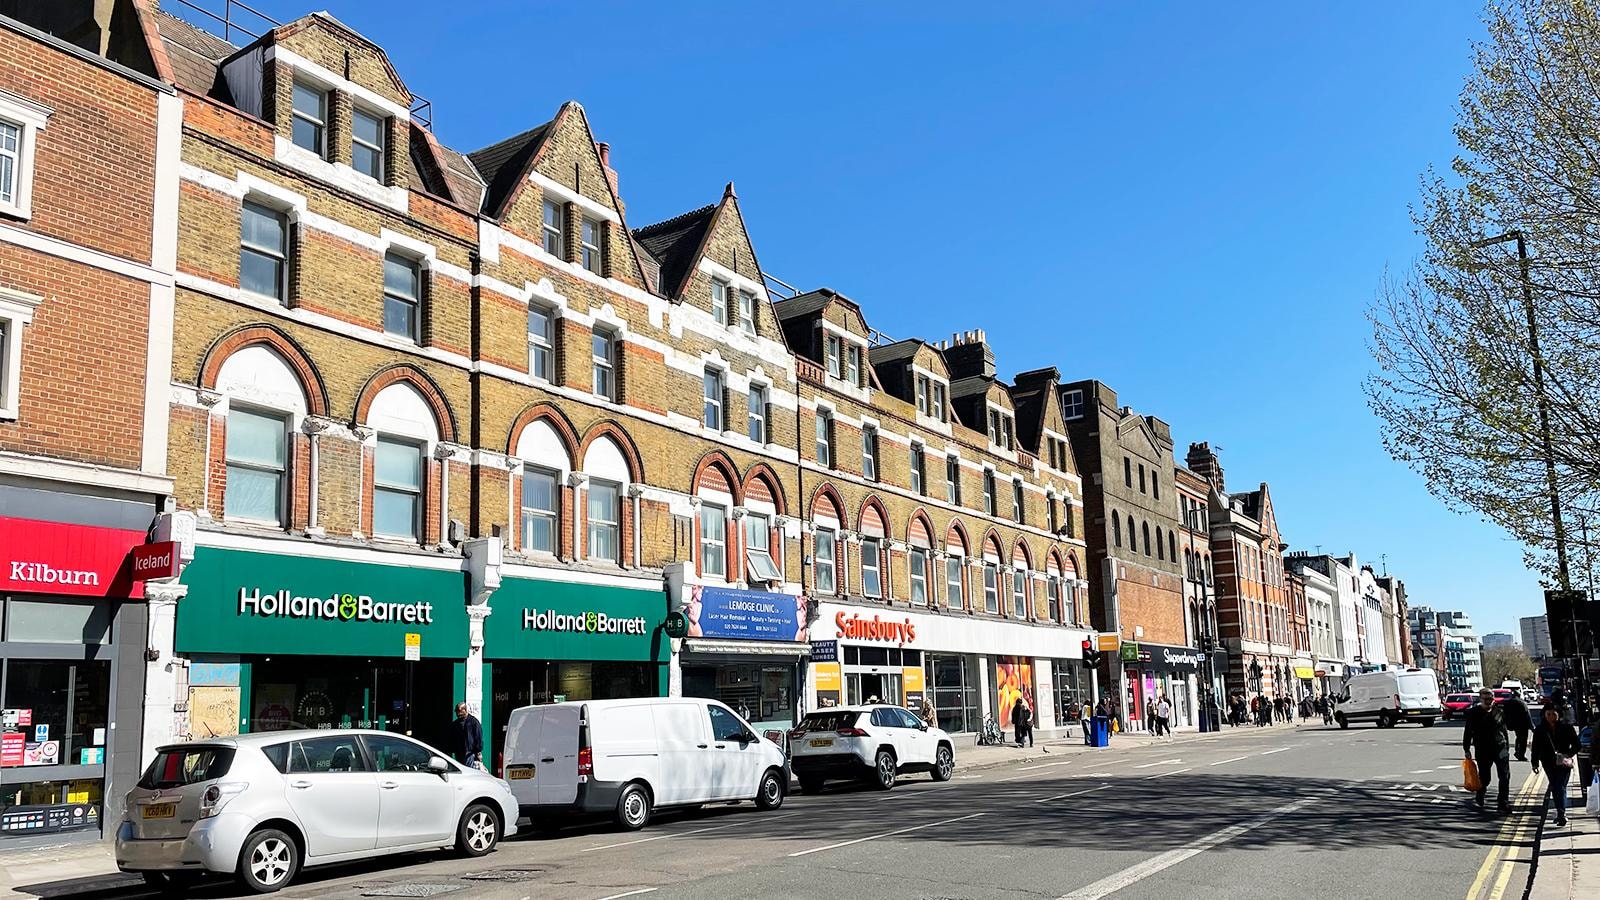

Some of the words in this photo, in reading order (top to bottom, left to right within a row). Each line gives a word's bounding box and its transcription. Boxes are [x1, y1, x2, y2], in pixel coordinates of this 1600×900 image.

[135, 552, 170, 571] Iceland
[9, 561, 99, 586] Kilburn
[728, 600, 755, 612] LEMOGE
[756, 603, 774, 614] CLINIC
[836, 611, 916, 647] Sainsbury's
[1163, 648, 1198, 668] Superdrug
